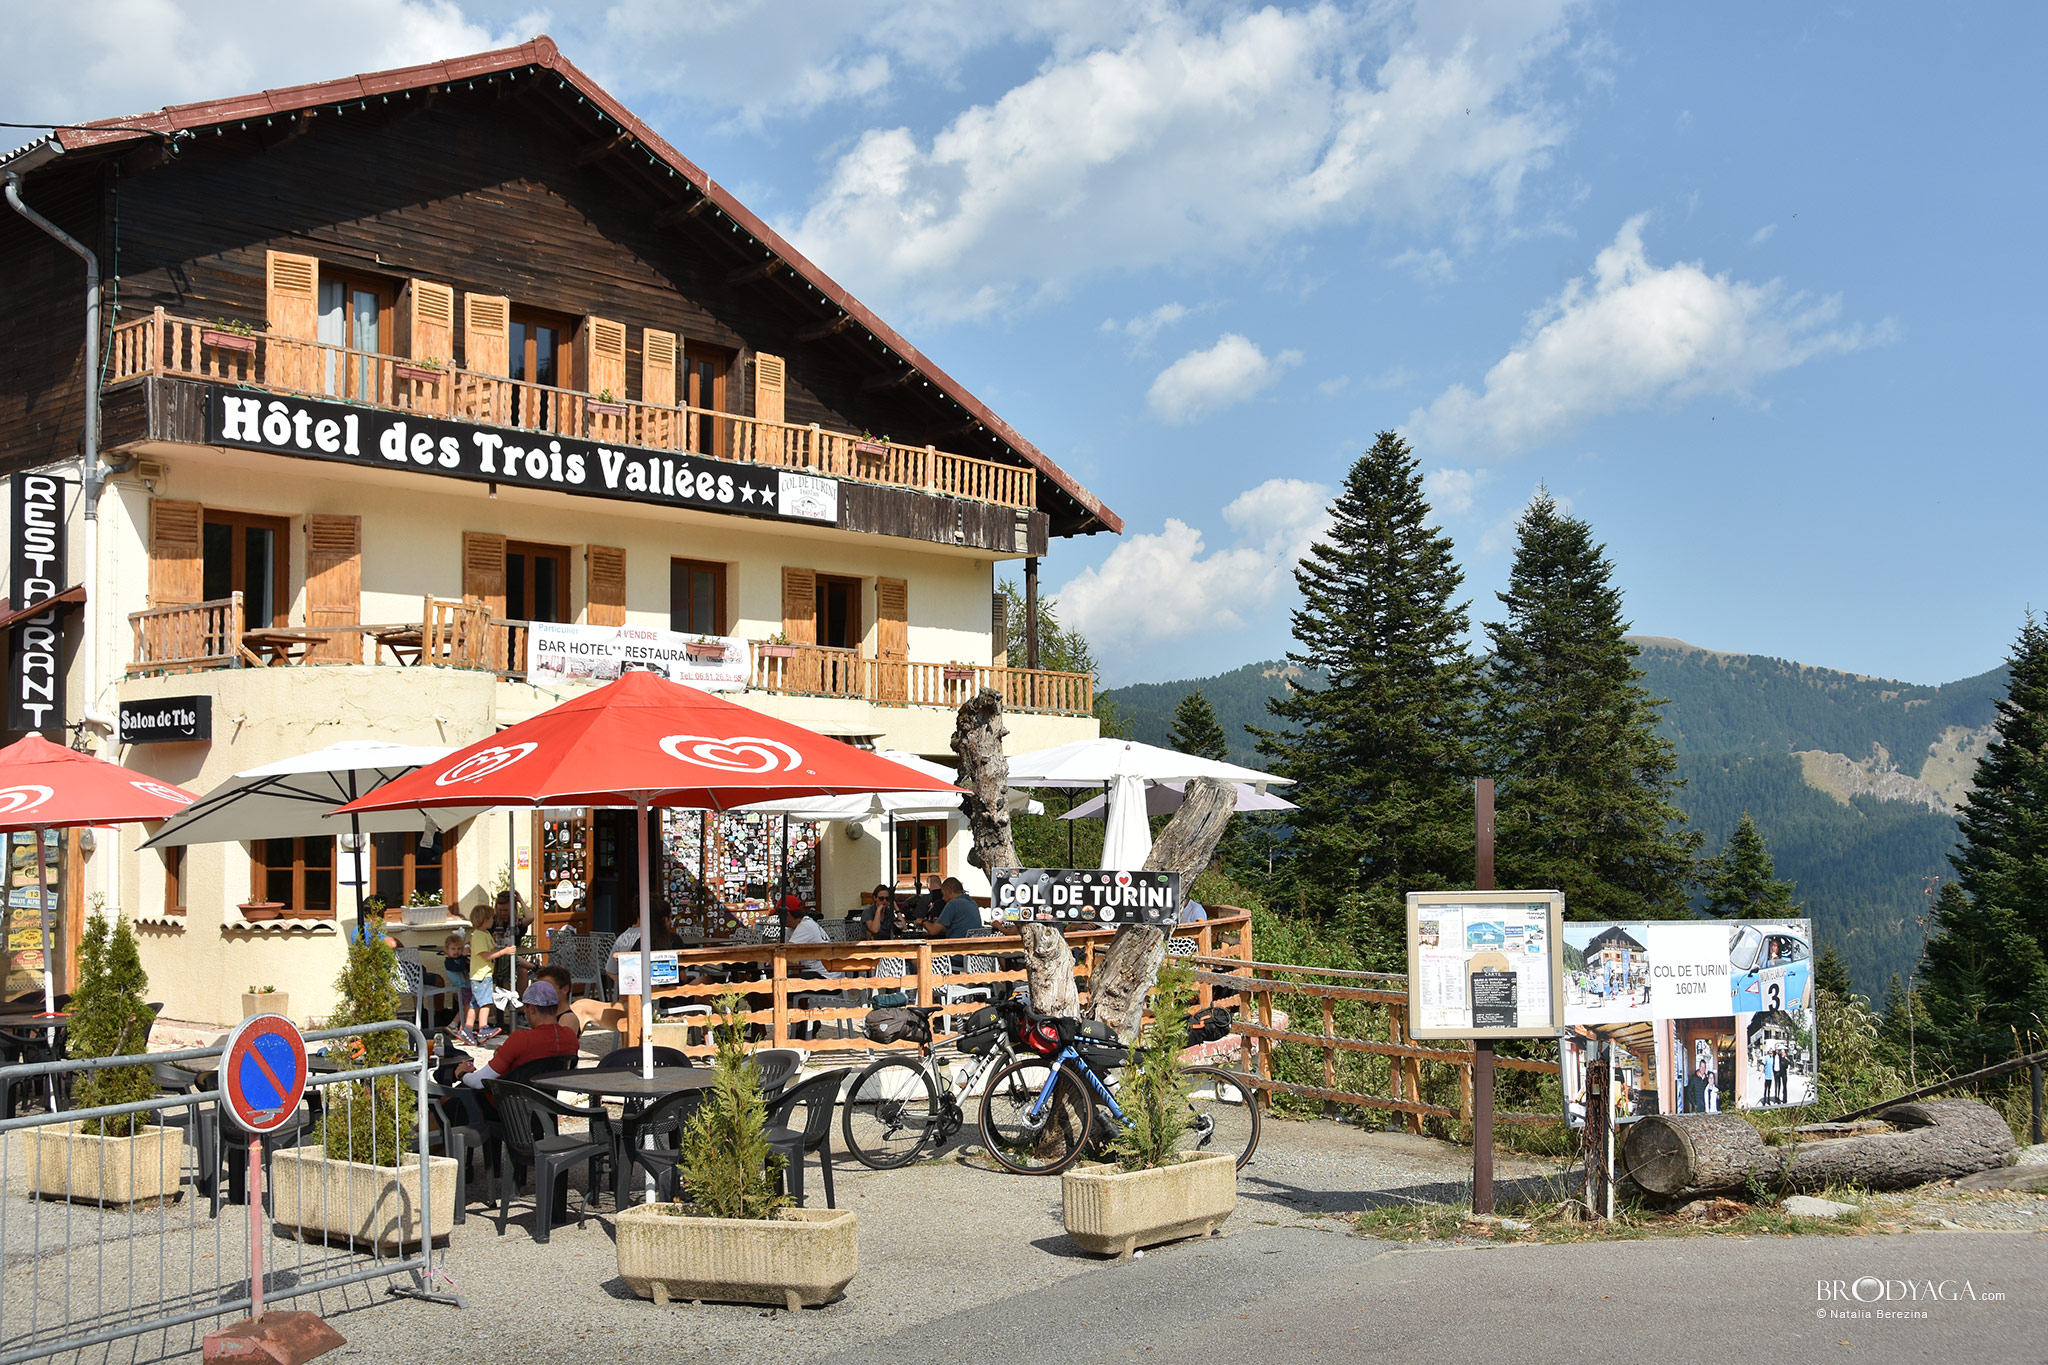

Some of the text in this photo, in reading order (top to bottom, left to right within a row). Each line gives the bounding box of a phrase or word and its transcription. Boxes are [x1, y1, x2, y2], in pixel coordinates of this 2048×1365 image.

[222, 395, 735, 503] Hôtel des Trois Vallées
[781, 476, 837, 501] COL DE TURINI
[22, 476, 57, 728] RESTAURANT
[538, 623, 579, 635] Particulier
[623, 629, 658, 640] VENDRE
[538, 639, 566, 653] BAR
[120, 708, 196, 730] Salon de The
[1000, 883, 1173, 907] COL DE TURINI
[1653, 964, 1728, 978] COL DE TURINI
[1676, 982, 1707, 995] 1607M
[1768, 983, 1780, 1012] 3
